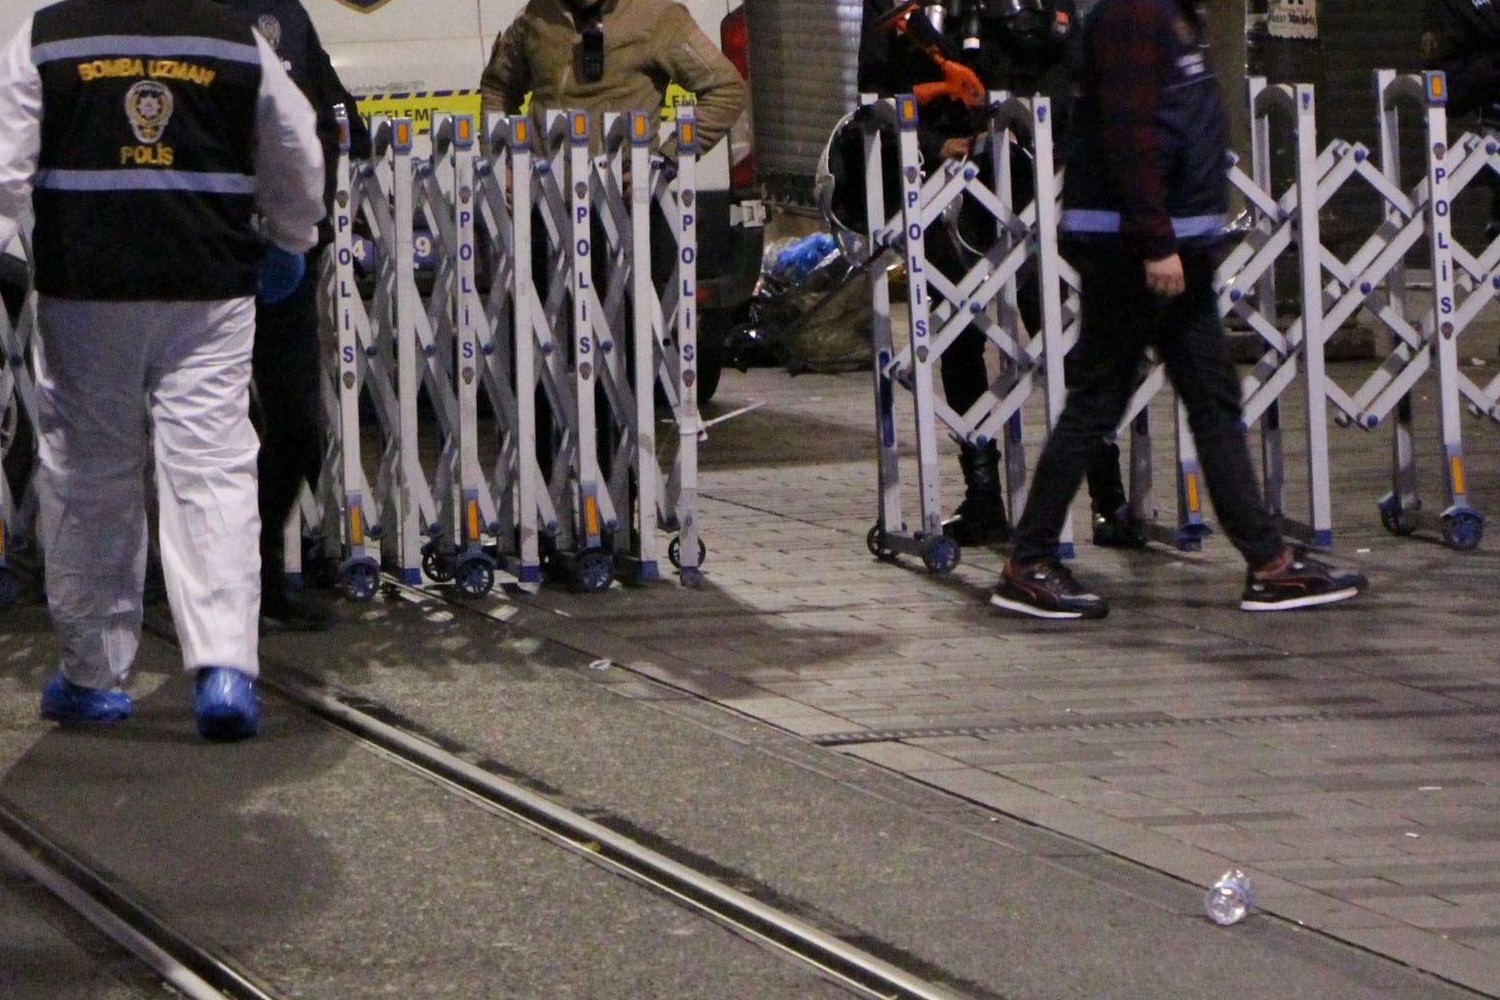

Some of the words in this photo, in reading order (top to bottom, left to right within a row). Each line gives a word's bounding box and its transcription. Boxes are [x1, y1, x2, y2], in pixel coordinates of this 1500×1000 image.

[78, 58, 144, 81] BOMBA
[119, 142, 174, 166] POLİS
[338, 215, 354, 364] POLİS
[460, 211, 473, 359] POLİS
[576, 206, 590, 354] POLİS
[681, 215, 694, 362] POLİS
[908, 191, 927, 338] POLİS
[1435, 167, 1453, 314] POLİS
